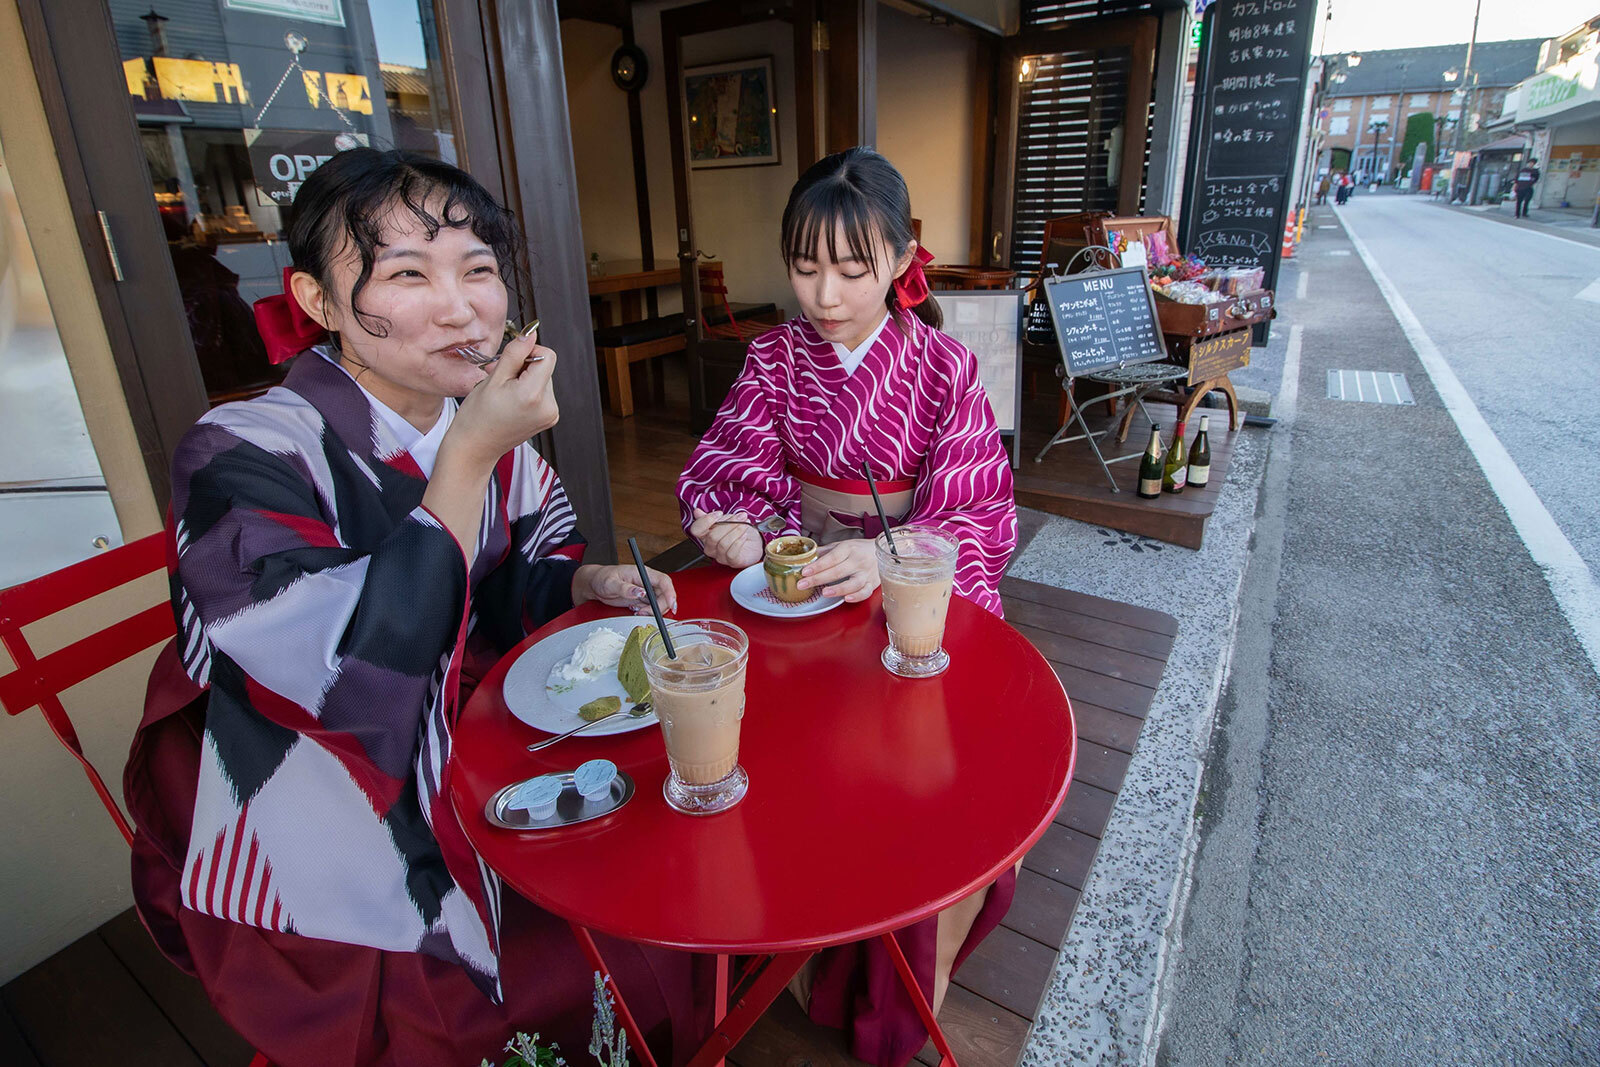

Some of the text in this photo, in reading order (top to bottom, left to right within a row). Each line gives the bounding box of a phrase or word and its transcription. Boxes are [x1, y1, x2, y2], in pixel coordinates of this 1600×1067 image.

[1222, 72, 1276, 91] 期間限定
[269, 153, 333, 181] OP
[1083, 278, 1114, 292] MENU
